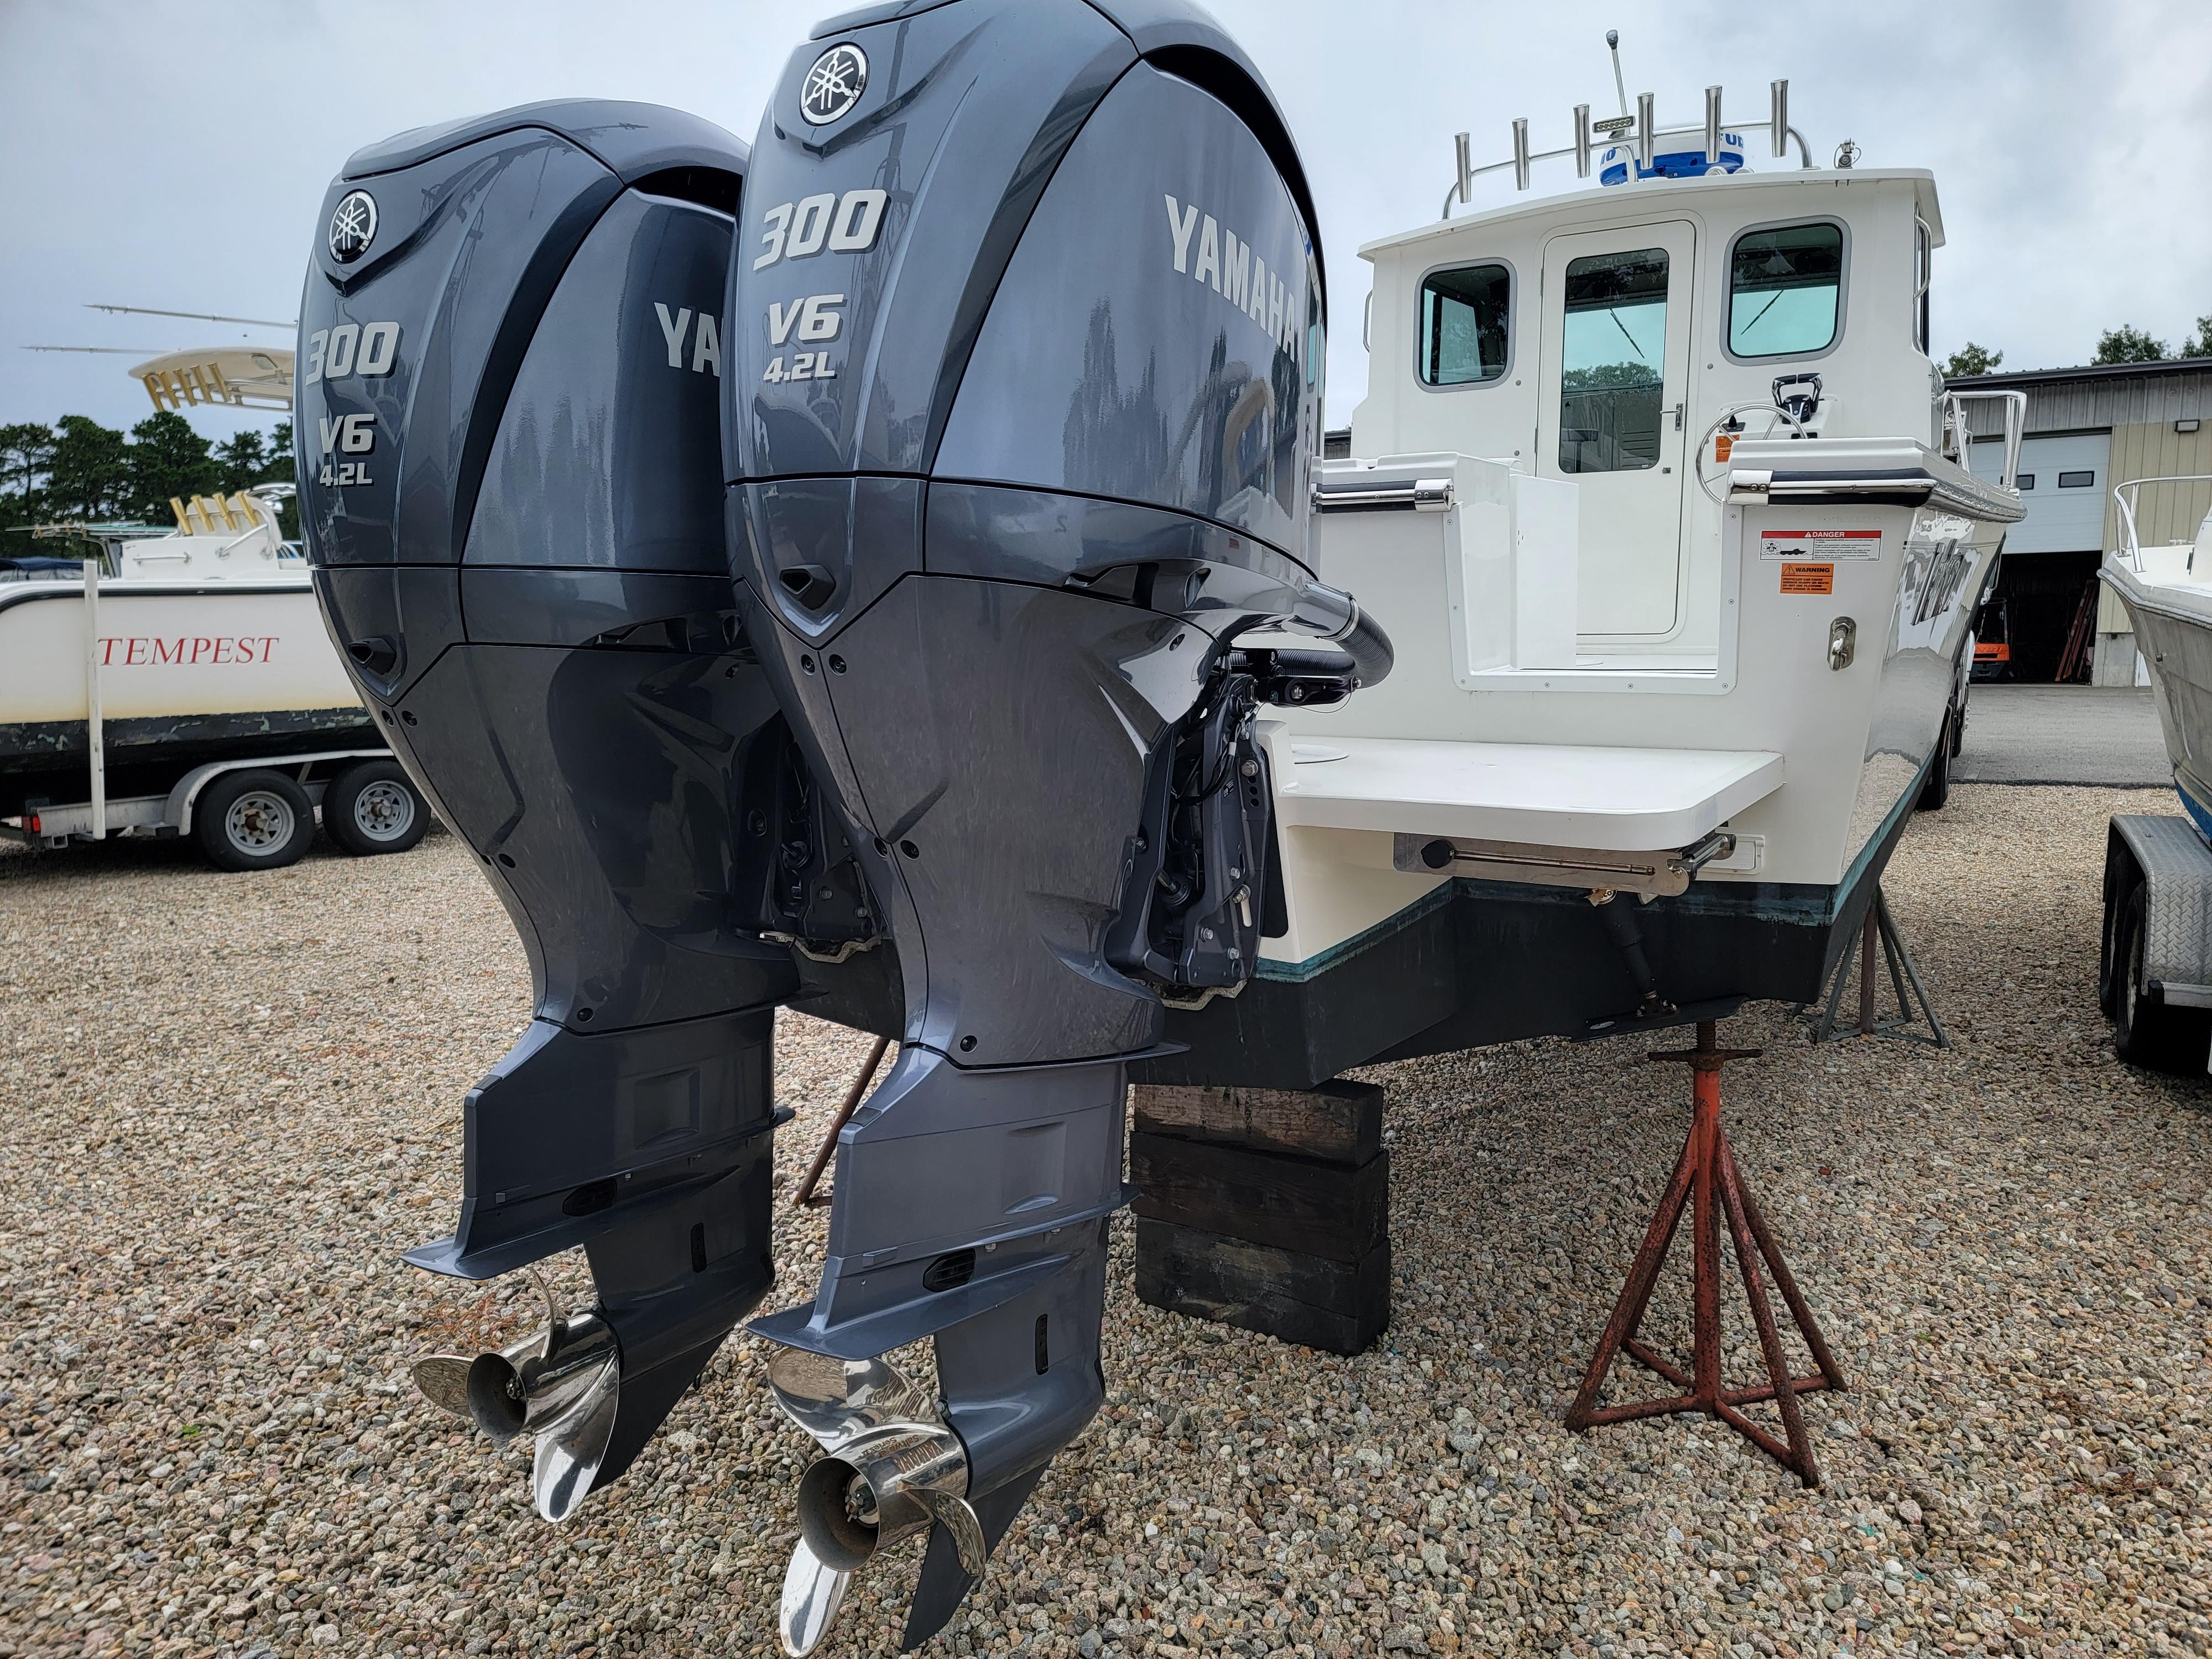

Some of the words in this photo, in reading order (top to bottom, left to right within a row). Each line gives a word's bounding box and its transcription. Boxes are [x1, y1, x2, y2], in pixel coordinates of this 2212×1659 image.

[753, 189, 890, 273] 300
[1164, 194, 1295, 363] YAMAHA
[769, 294, 846, 346] V6
[305, 322, 402, 386] 300
[763, 351, 836, 383] 4.2L
[319, 414, 376, 455] V6
[319, 462, 373, 487] 4.2L
[97, 637, 279, 666] TEMPEST
[891, 1440, 944, 1474] YAMAHA
